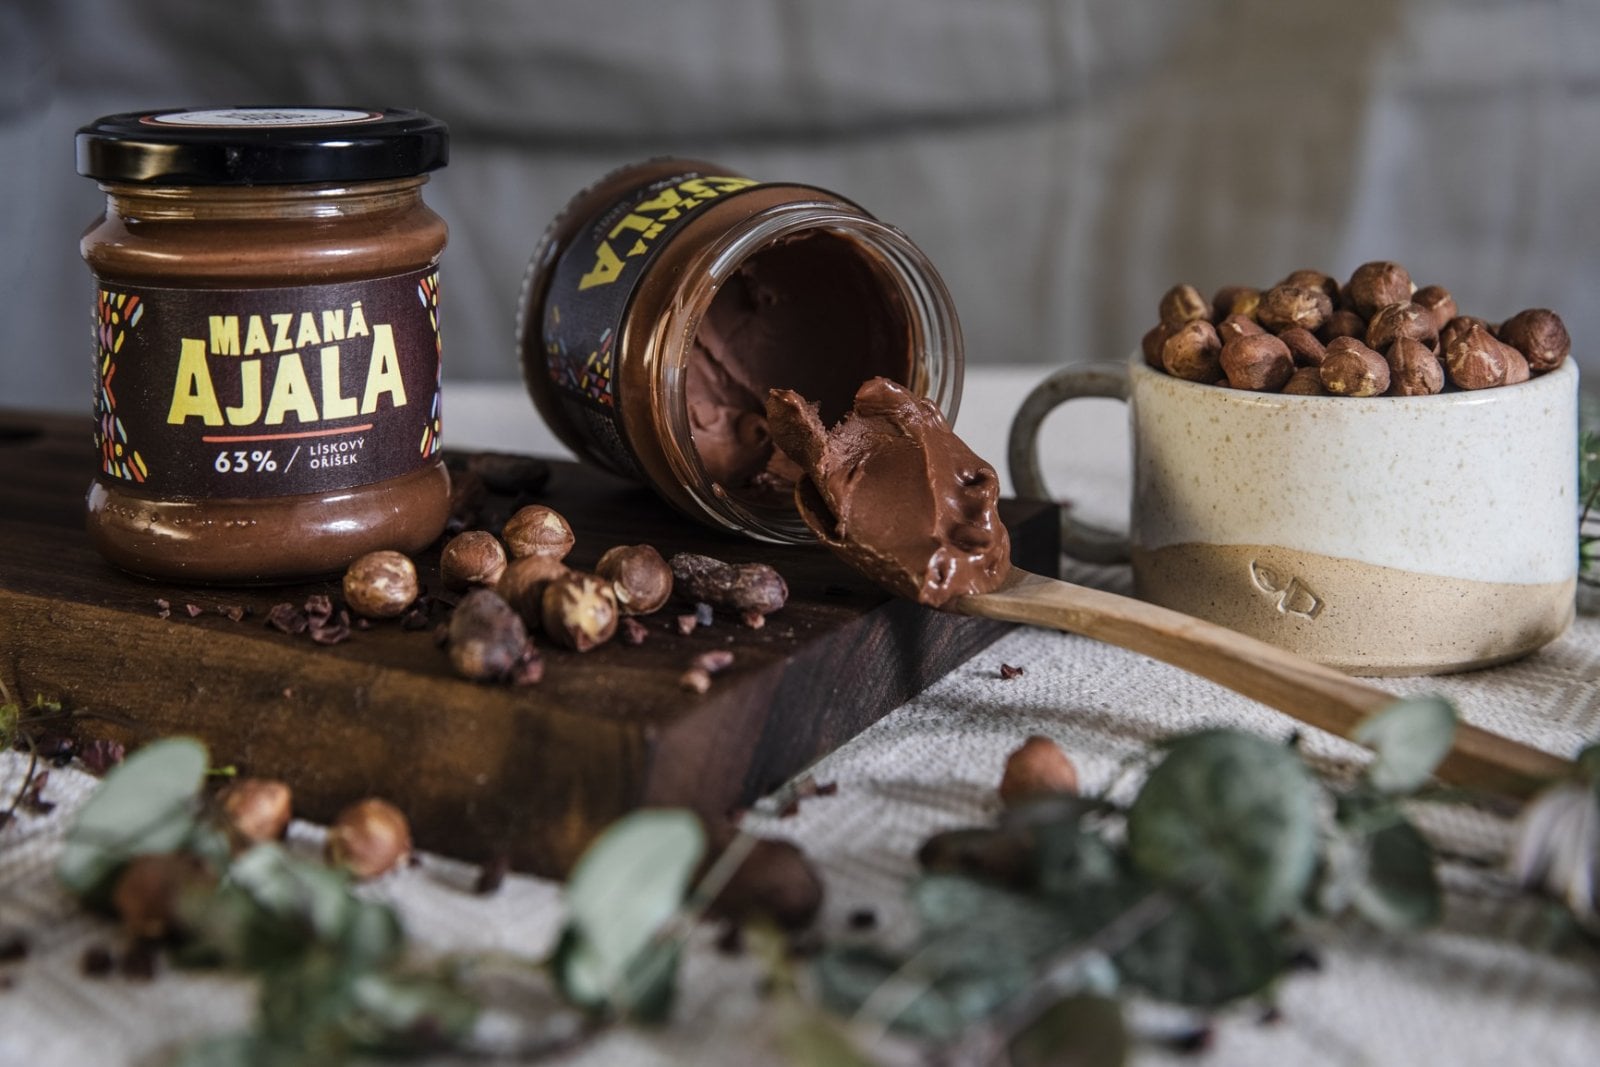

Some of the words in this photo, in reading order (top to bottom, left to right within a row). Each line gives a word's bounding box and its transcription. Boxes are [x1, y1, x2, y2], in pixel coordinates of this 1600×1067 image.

[208, 301, 370, 356] MAZANÁ
[167, 324, 407, 426] AJALA
[309, 438, 365, 456] LÍSKOVÝ
[214, 450, 277, 473] 63%
[309, 453, 358, 469] OŘÍŠEK
